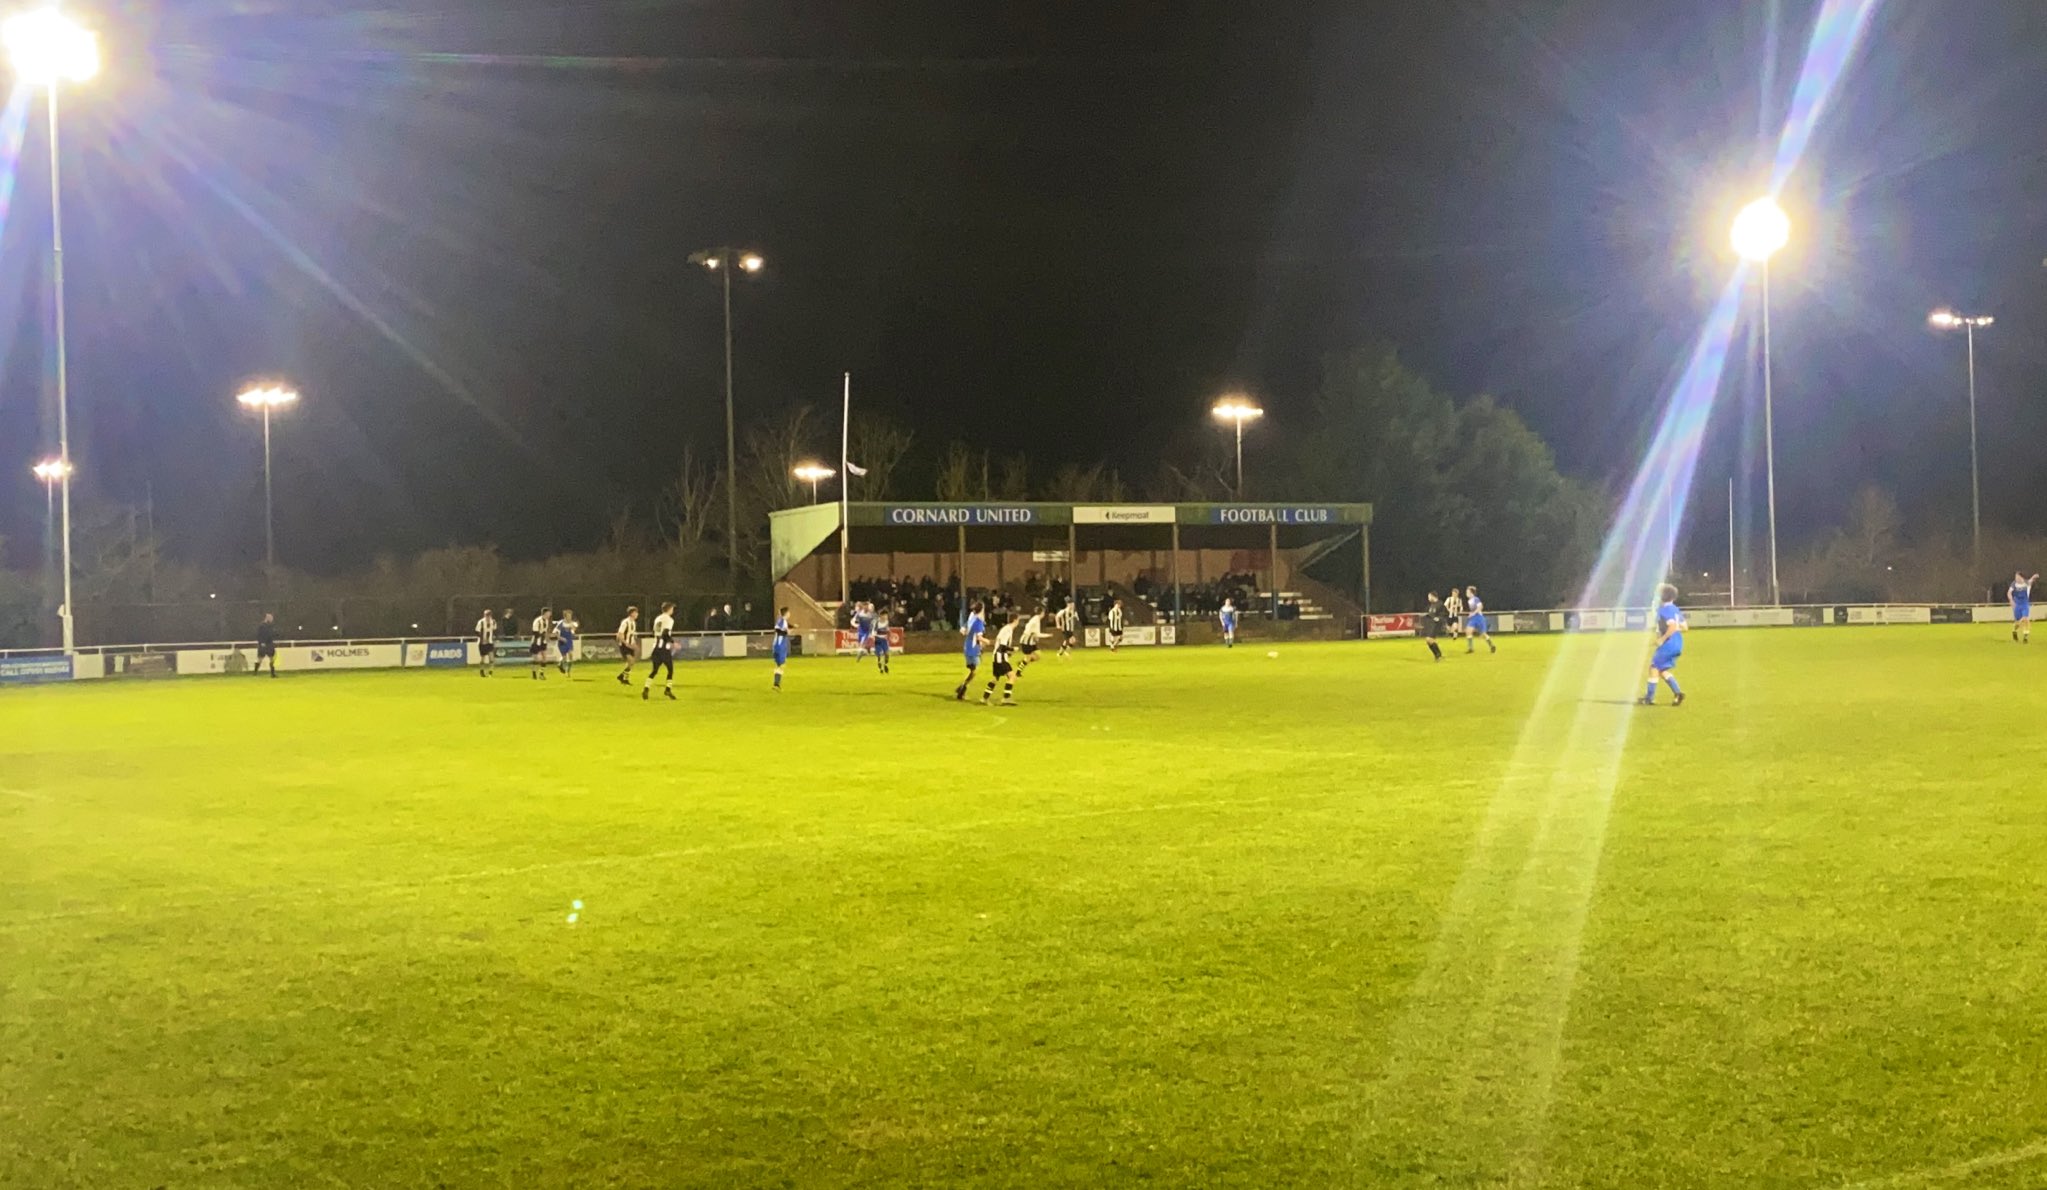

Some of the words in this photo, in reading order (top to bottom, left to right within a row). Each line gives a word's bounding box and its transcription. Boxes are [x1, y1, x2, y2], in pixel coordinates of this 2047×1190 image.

[892, 508, 970, 523] CORNARD
[976, 508, 1031, 523] UNITED
[1111, 511, 1149, 520] Keepmoat
[1220, 508, 1288, 523] FOOTBALL
[1294, 508, 1328, 522] CLUB
[327, 647, 370, 658] HOLMES
